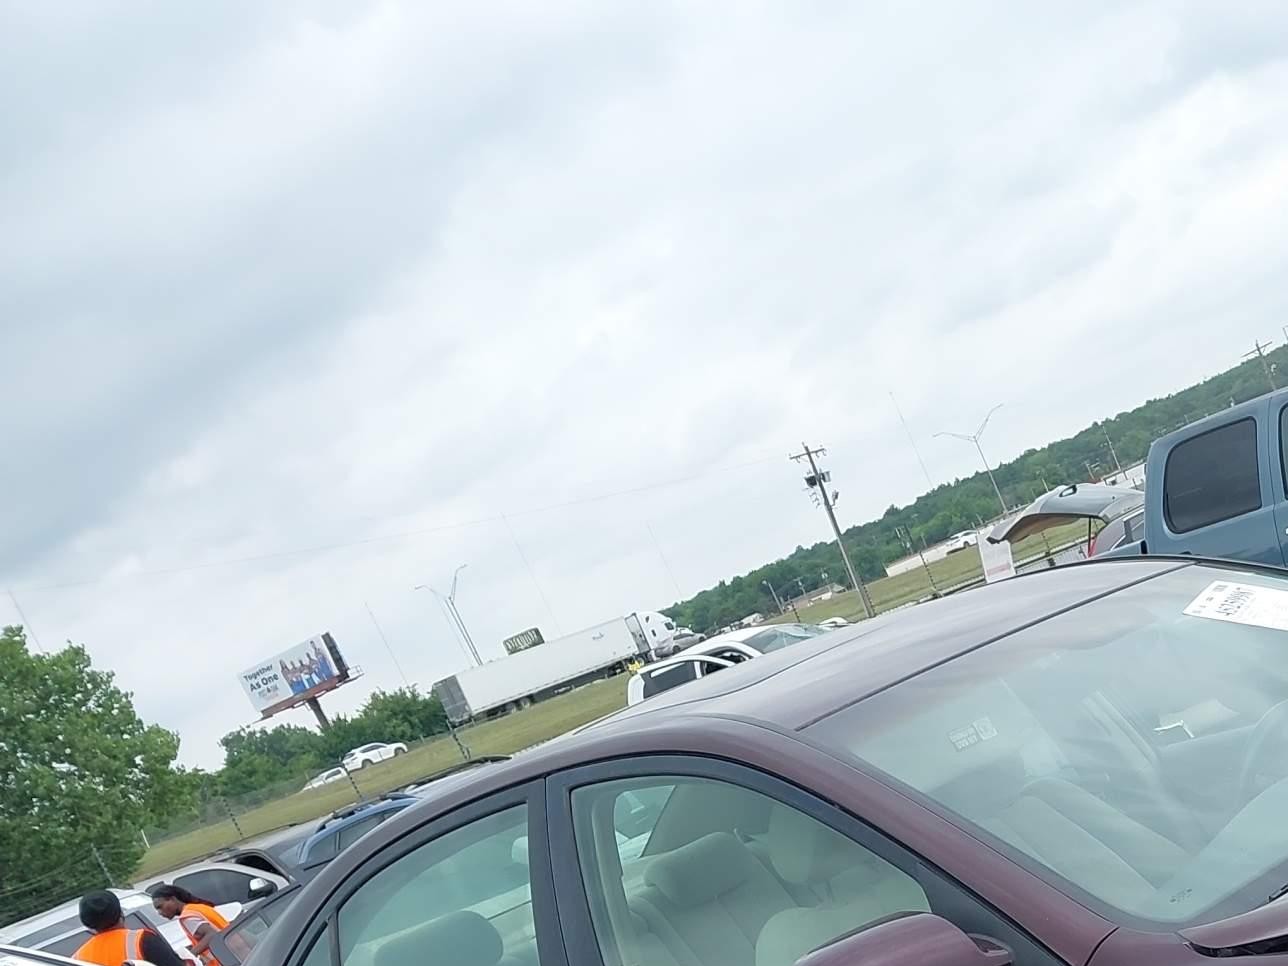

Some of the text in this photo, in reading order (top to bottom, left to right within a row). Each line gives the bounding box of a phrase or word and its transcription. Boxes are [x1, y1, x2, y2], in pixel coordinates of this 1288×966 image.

[242, 663, 274, 682] Together
[249, 680, 262, 692] As
[261, 672, 280, 686] One
